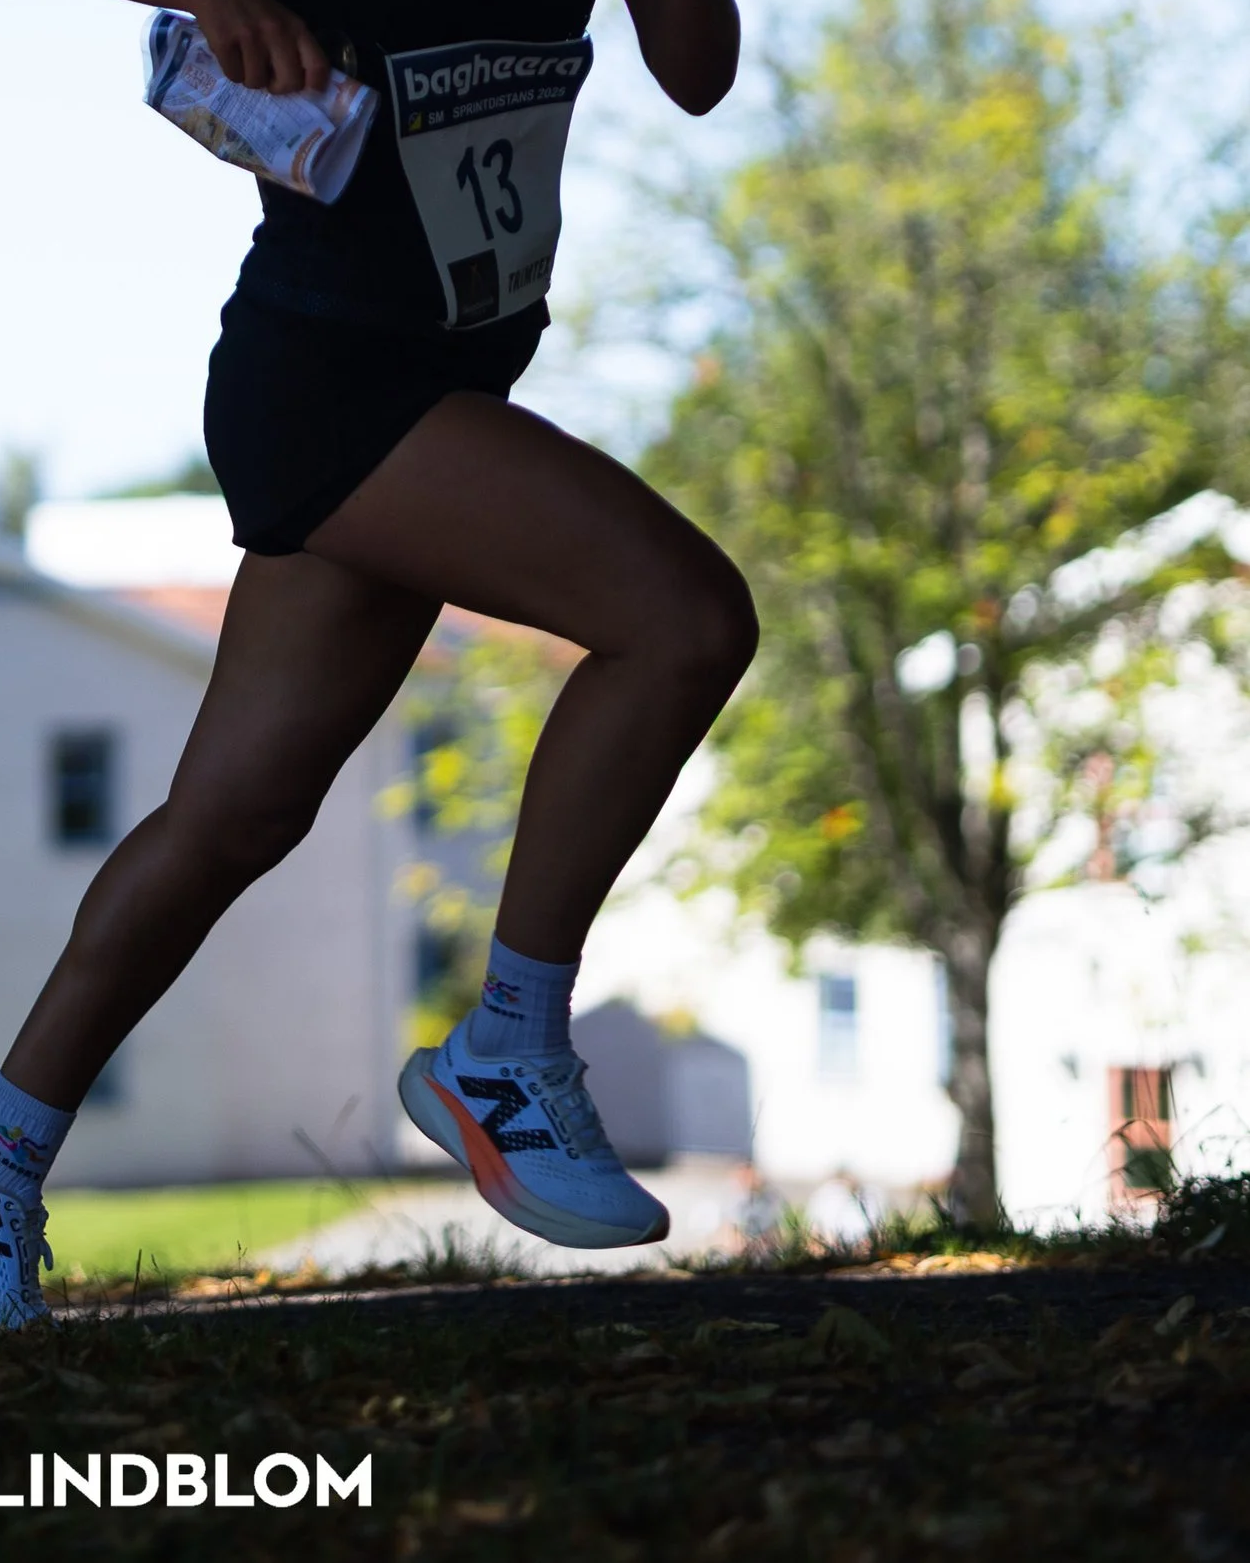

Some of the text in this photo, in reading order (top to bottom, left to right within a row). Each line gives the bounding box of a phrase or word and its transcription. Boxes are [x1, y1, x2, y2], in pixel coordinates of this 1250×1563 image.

[404, 53, 584, 101] bagheera
[428, 111, 445, 125] SM
[452, 89, 534, 119] SPRINTDISTANS
[456, 138, 523, 240] 13
